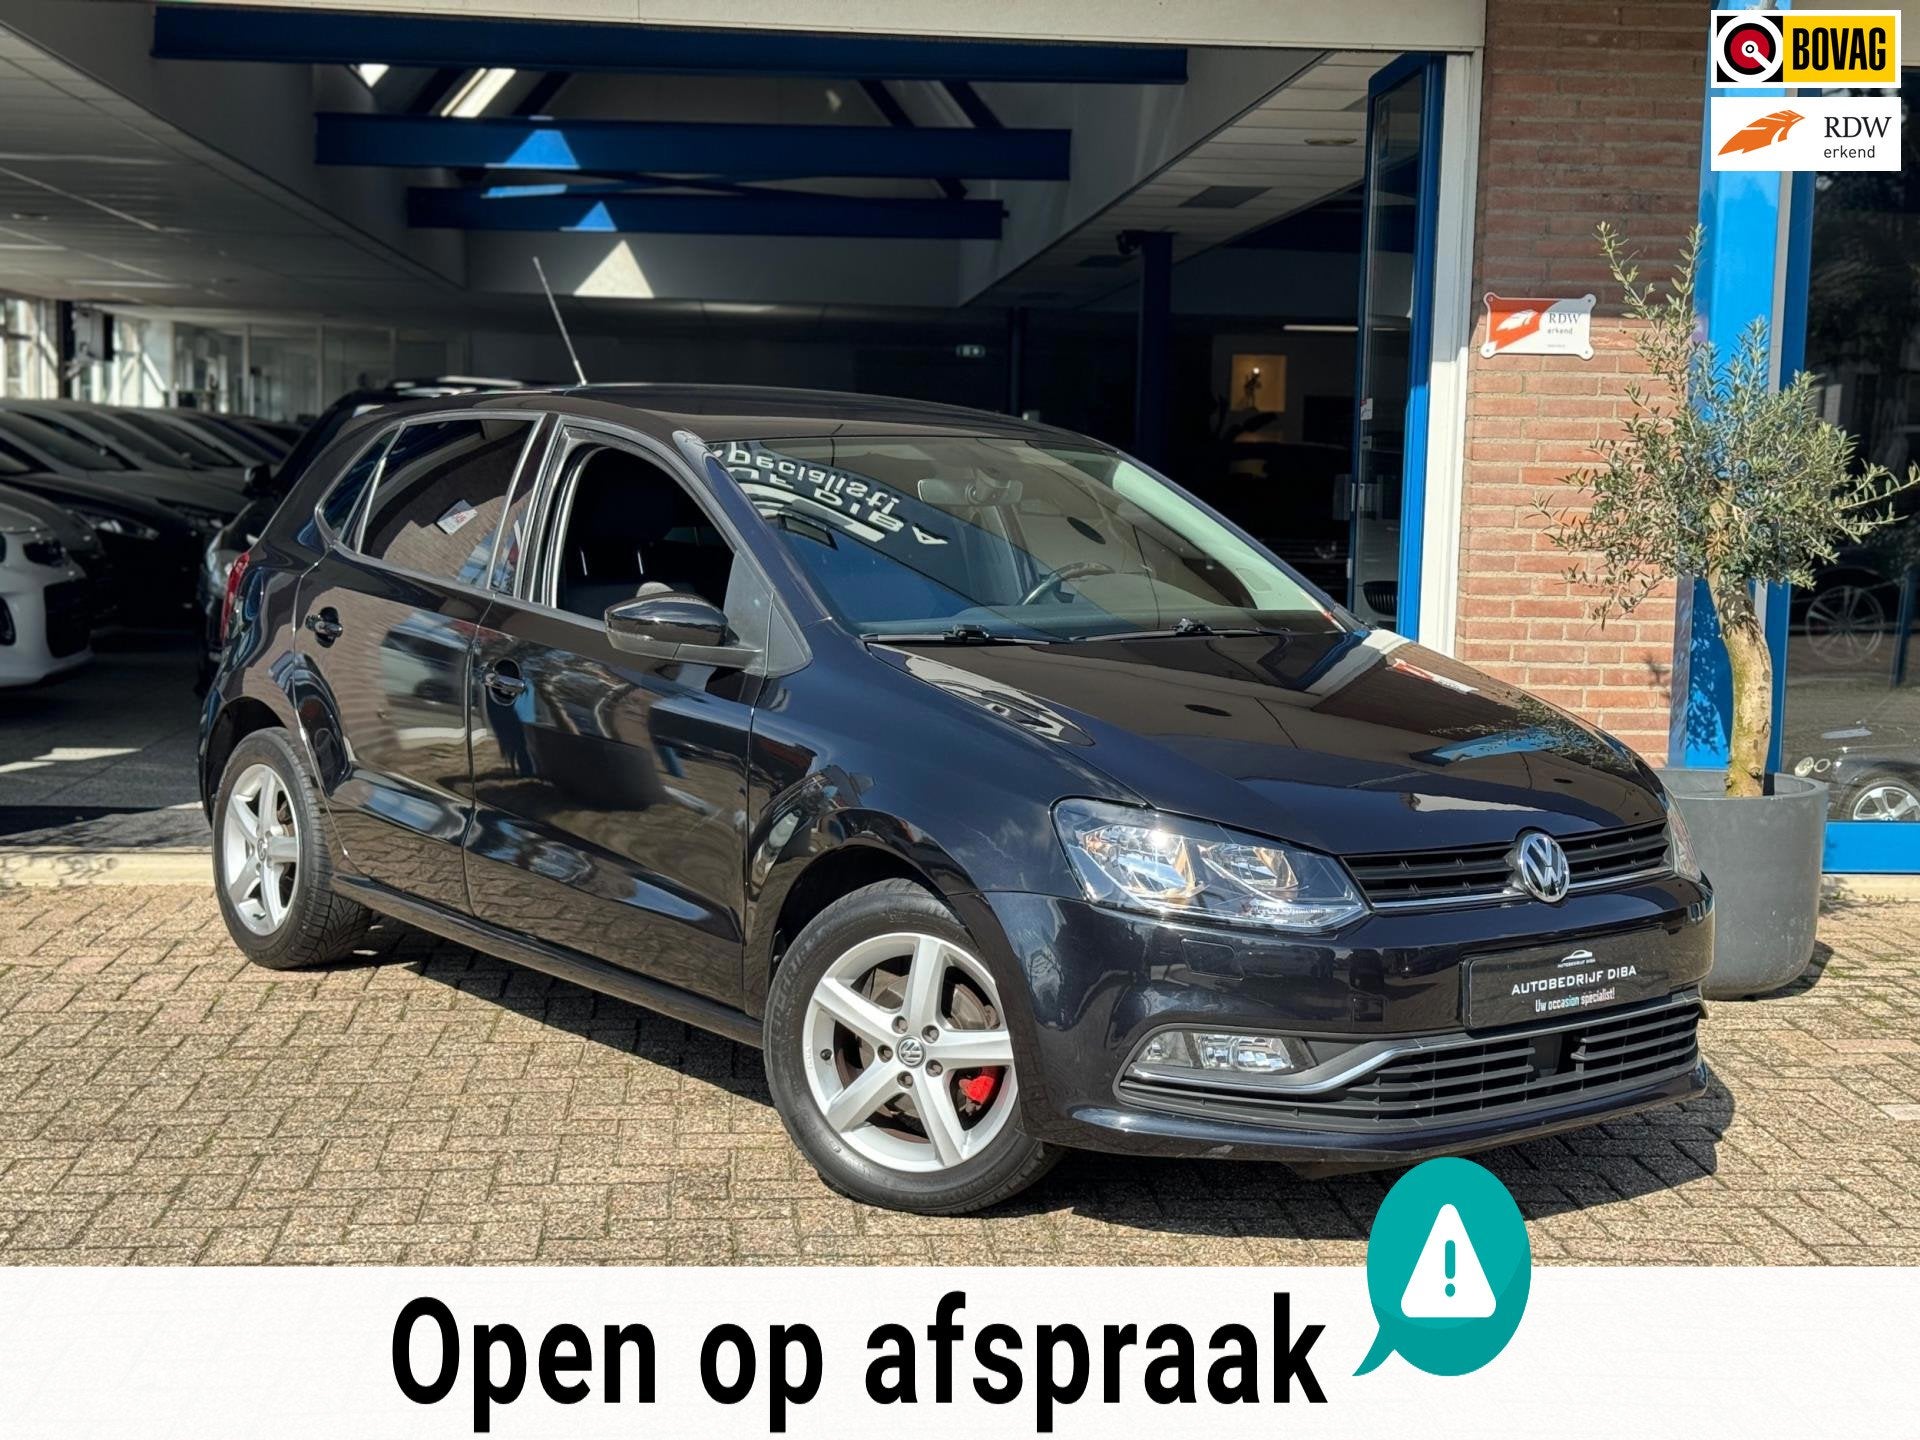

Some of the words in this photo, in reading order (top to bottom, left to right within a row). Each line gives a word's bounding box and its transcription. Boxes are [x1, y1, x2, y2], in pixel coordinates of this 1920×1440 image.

[1548, 312, 1580, 325] RDW
[1547, 327, 1573, 335] erkend
[1511, 970, 1604, 996] AUTOBEDRIJF
[1607, 965, 1637, 980] DIBA
[1535, 999, 1547, 1012] Uw
[1548, 995, 1580, 1010] occasion
[1580, 986, 1616, 1006] specialist!
